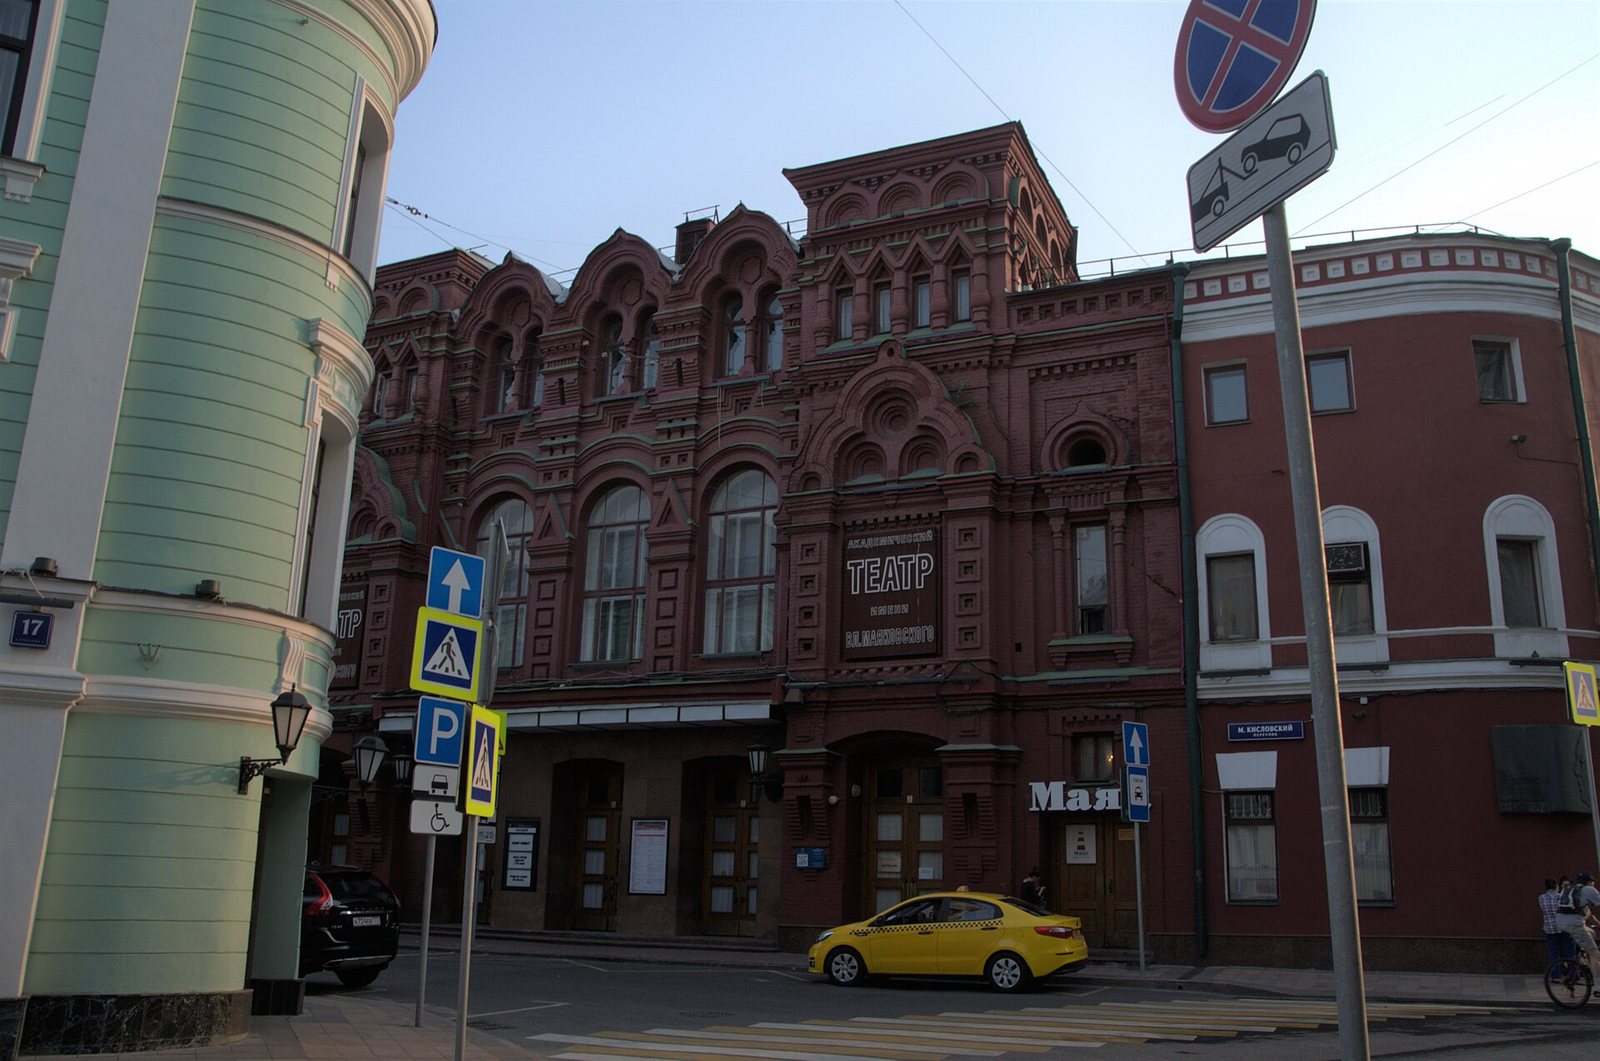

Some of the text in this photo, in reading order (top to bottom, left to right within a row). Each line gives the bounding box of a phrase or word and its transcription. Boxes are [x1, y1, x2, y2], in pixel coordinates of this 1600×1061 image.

[847, 553, 933, 595] ТЕАТР
[22, 618, 44, 636] 17
[430, 707, 459, 754] P
[1247, 723, 1293, 733] КИСЛОВСКИЙ
